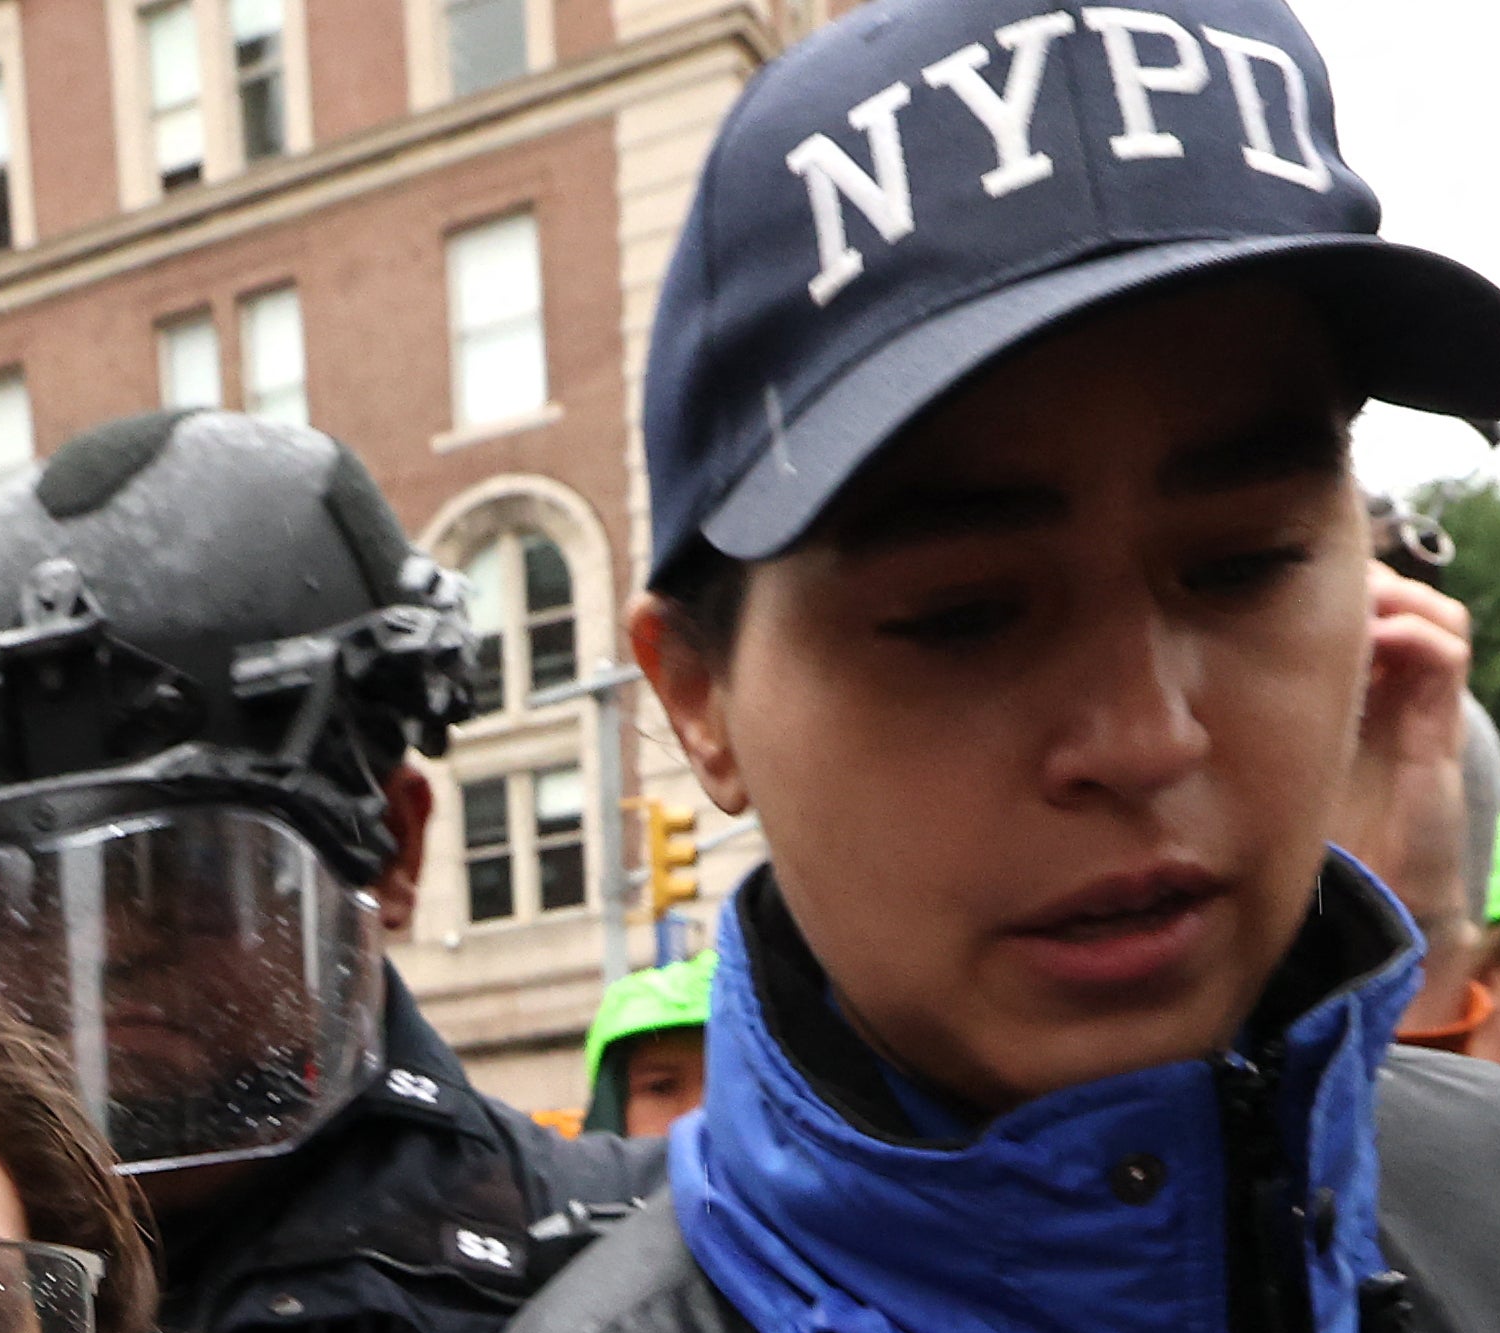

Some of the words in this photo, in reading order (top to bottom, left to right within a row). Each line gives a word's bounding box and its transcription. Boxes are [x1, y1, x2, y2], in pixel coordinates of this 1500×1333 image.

[786, 6, 1333, 307] NYPD
[386, 1069, 440, 1104] S2
[456, 1229, 512, 1268] S2
